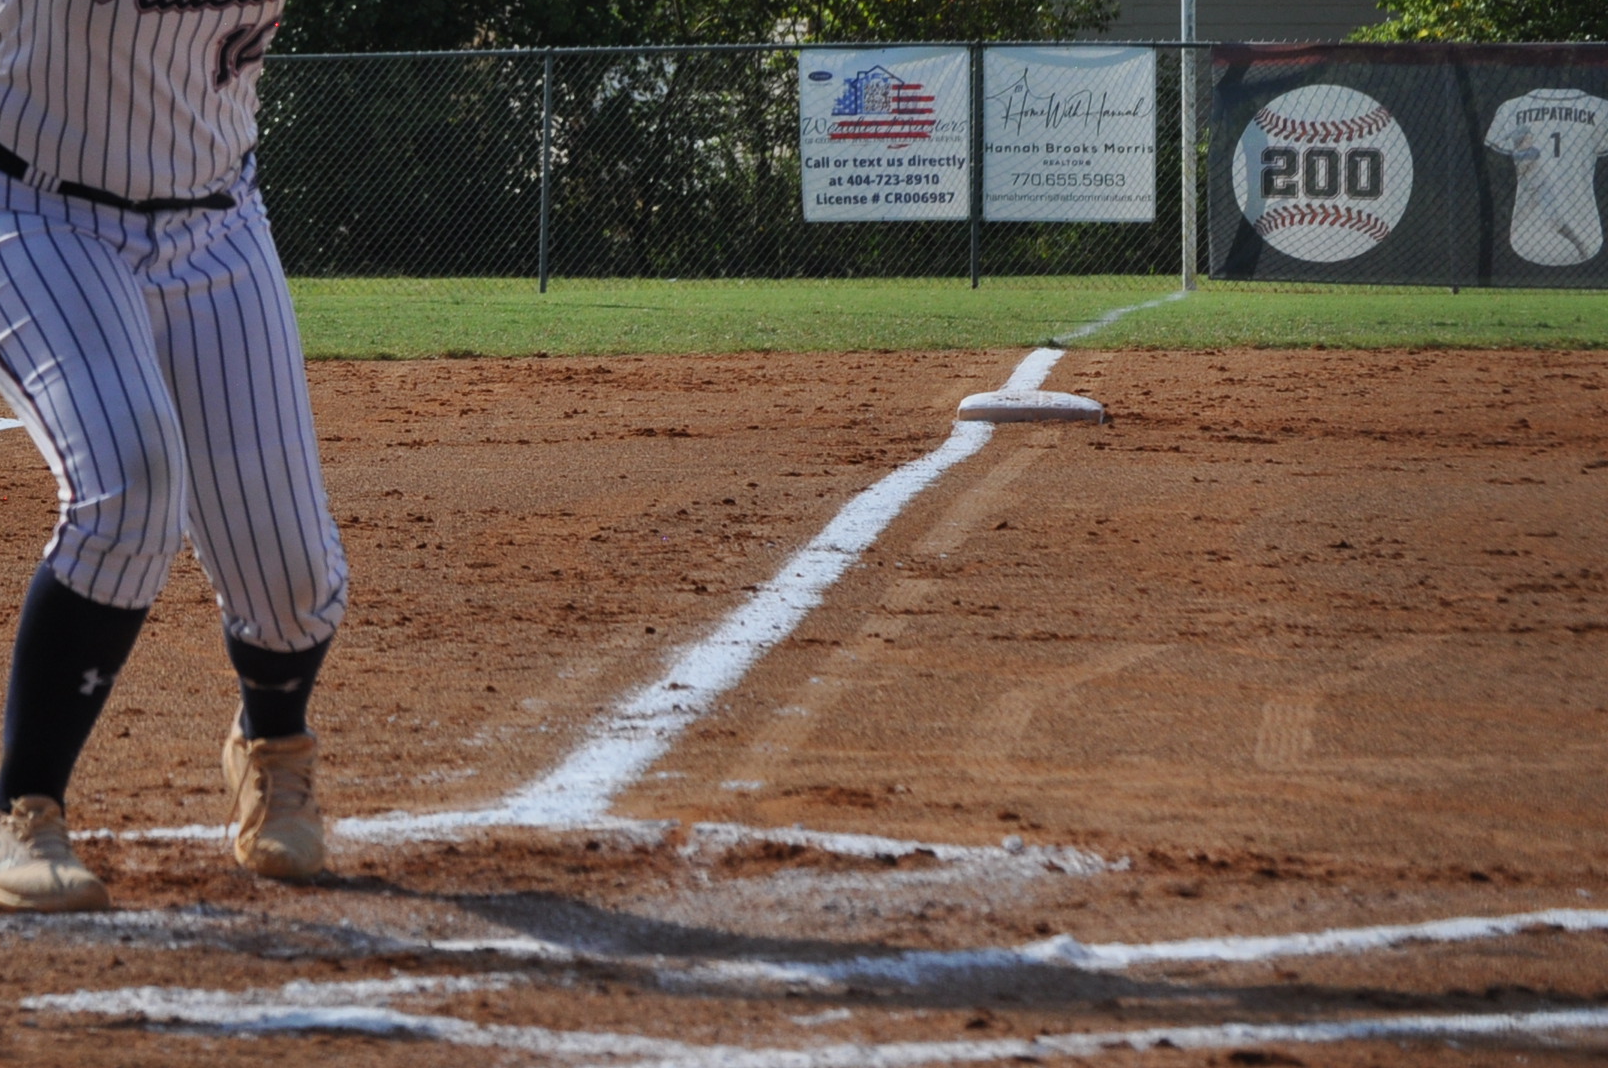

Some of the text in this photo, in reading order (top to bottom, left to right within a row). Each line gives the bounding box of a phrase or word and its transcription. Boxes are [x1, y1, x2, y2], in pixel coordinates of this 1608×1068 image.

[1515, 107, 1596, 126] FITZPATRICK
[984, 143, 1154, 154] Hannah Brooks Morris
[1550, 132, 1561, 158] 1
[805, 155, 966, 169] Call or text us directly
[829, 174, 940, 186] at 404-723-8910
[1011, 173, 1126, 187] 770.655.5963
[1261, 147, 1384, 200] 200
[816, 192, 955, 205] License # CR006987
